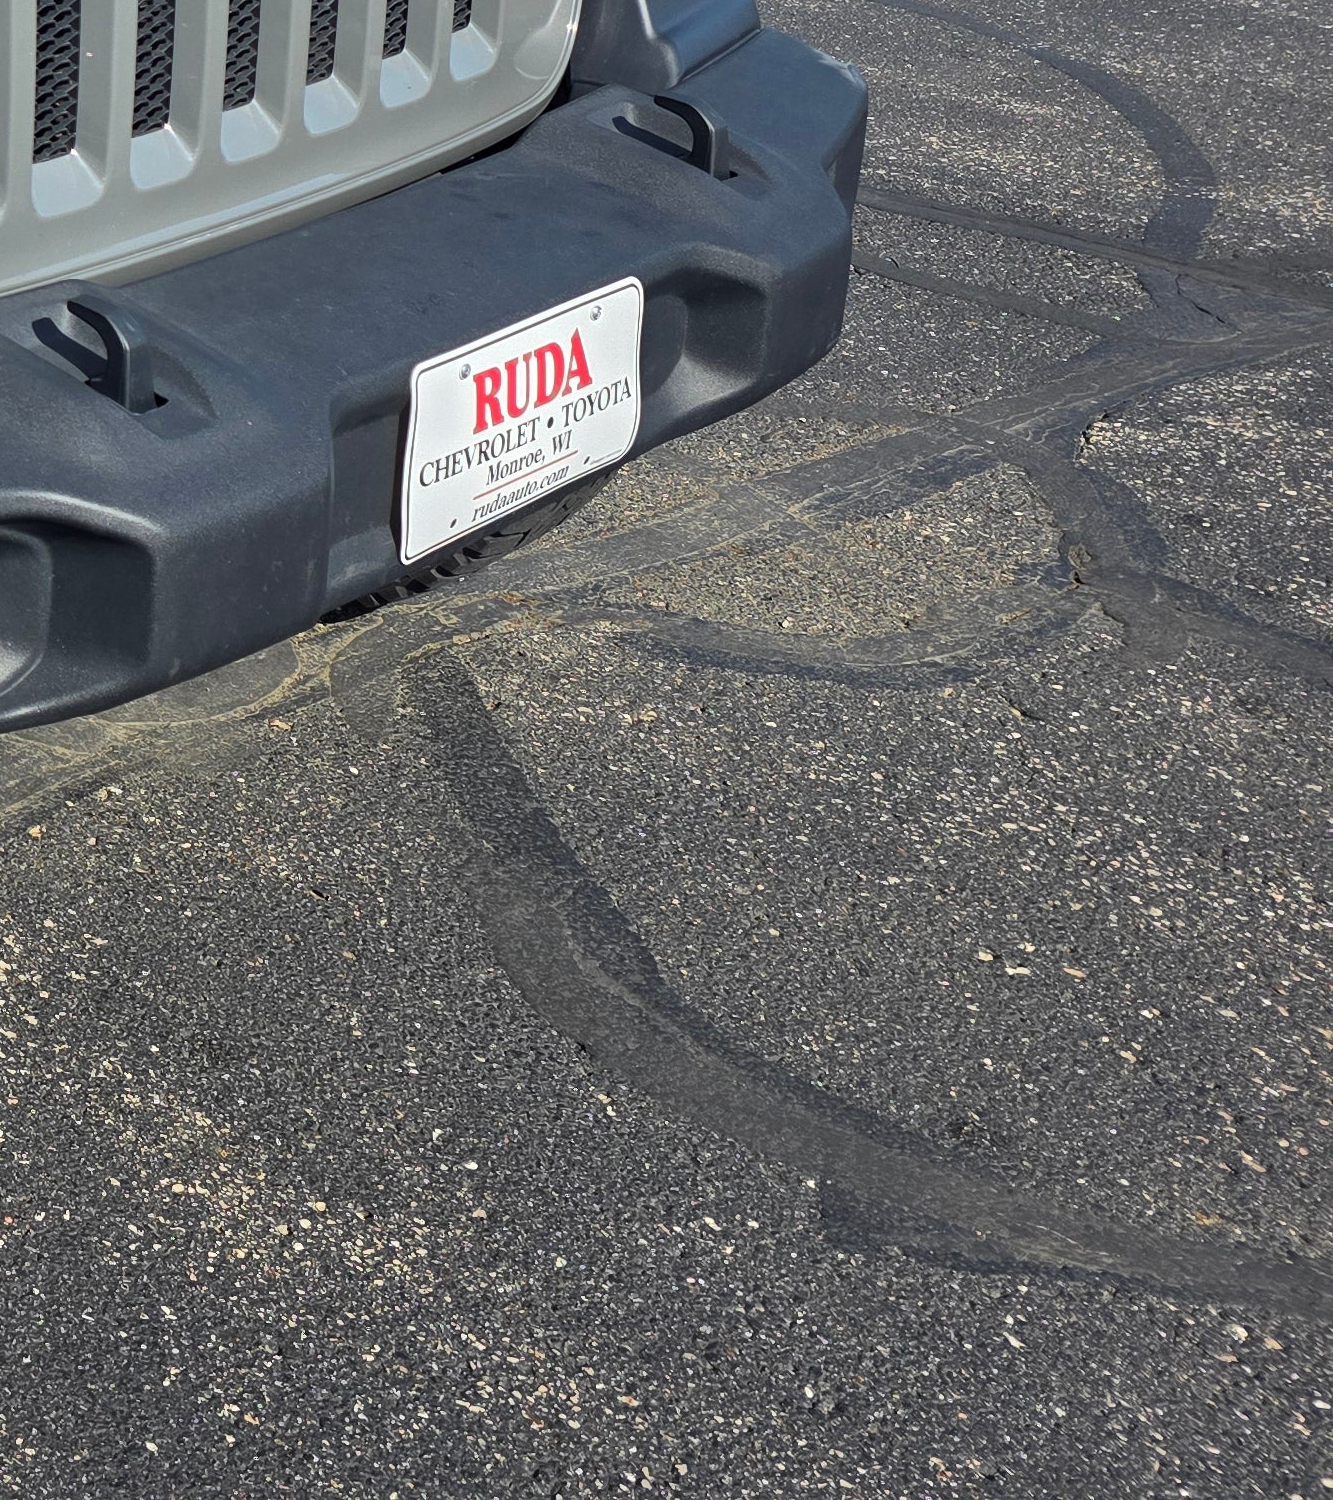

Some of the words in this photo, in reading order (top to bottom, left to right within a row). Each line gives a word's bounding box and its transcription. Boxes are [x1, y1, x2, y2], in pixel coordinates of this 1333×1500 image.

[473, 327, 593, 435] RUDA
[419, 416, 541, 488] CHEVROLET
[561, 376, 633, 428] TOYOTA
[485, 447, 546, 487] Monroe,
[552, 430, 573, 455] WI
[471, 464, 570, 523] rudaauto.com
